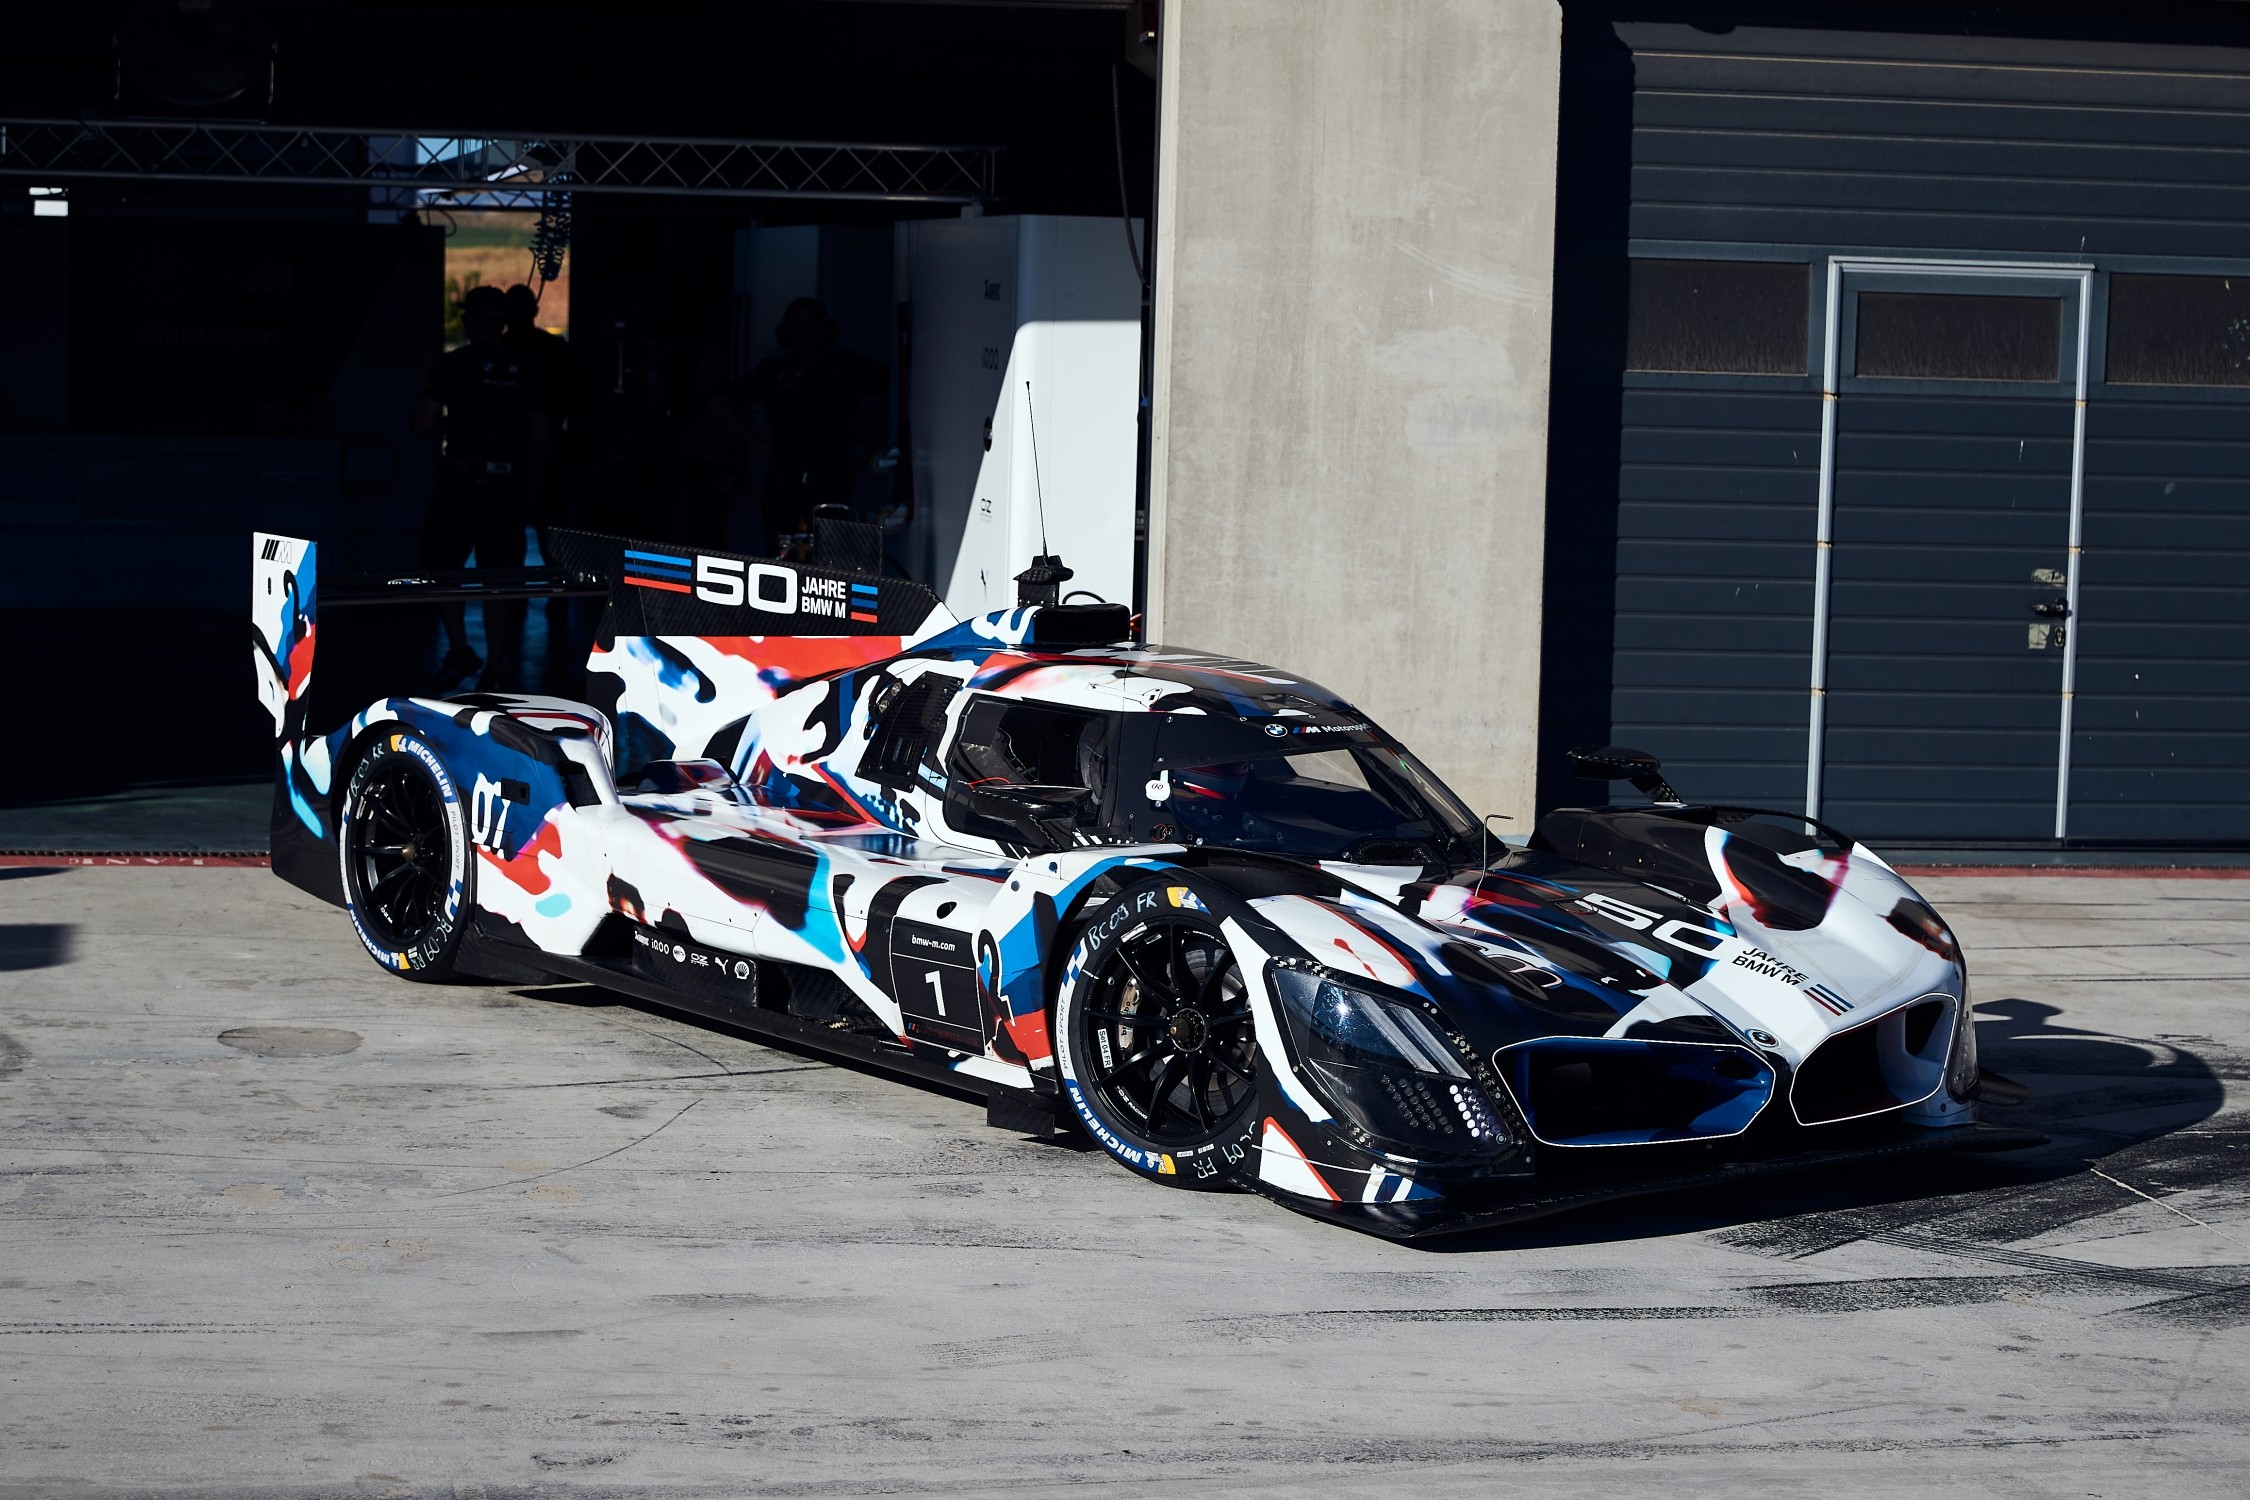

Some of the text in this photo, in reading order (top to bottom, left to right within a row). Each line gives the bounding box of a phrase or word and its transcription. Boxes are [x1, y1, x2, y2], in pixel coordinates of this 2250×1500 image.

[696, 555, 798, 614] 50
[801, 576, 846, 599] JAHRE
[801, 596, 846, 619] BMW M
[407, 740, 453, 798] MICHELIN
[451, 810, 459, 836] PILOT
[1088, 891, 1158, 951] BC09 FR
[1574, 893, 1738, 960] 50
[350, 909, 391, 965] MICHELIN
[911, 934, 956, 952] bmw-m.com
[1732, 955, 1802, 986] BMW M
[1742, 948, 1810, 981] JAHRE
[925, 970, 946, 1016] 1
[1060, 1040, 1068, 1069] PILOT
[1102, 1044, 1109, 1054] 04
[1104, 1055, 1112, 1066] FR
[1069, 1087, 1143, 1164] MICHELIN
[1127, 1101, 1148, 1120] RACING
[1192, 1156, 1218, 1179] FR
